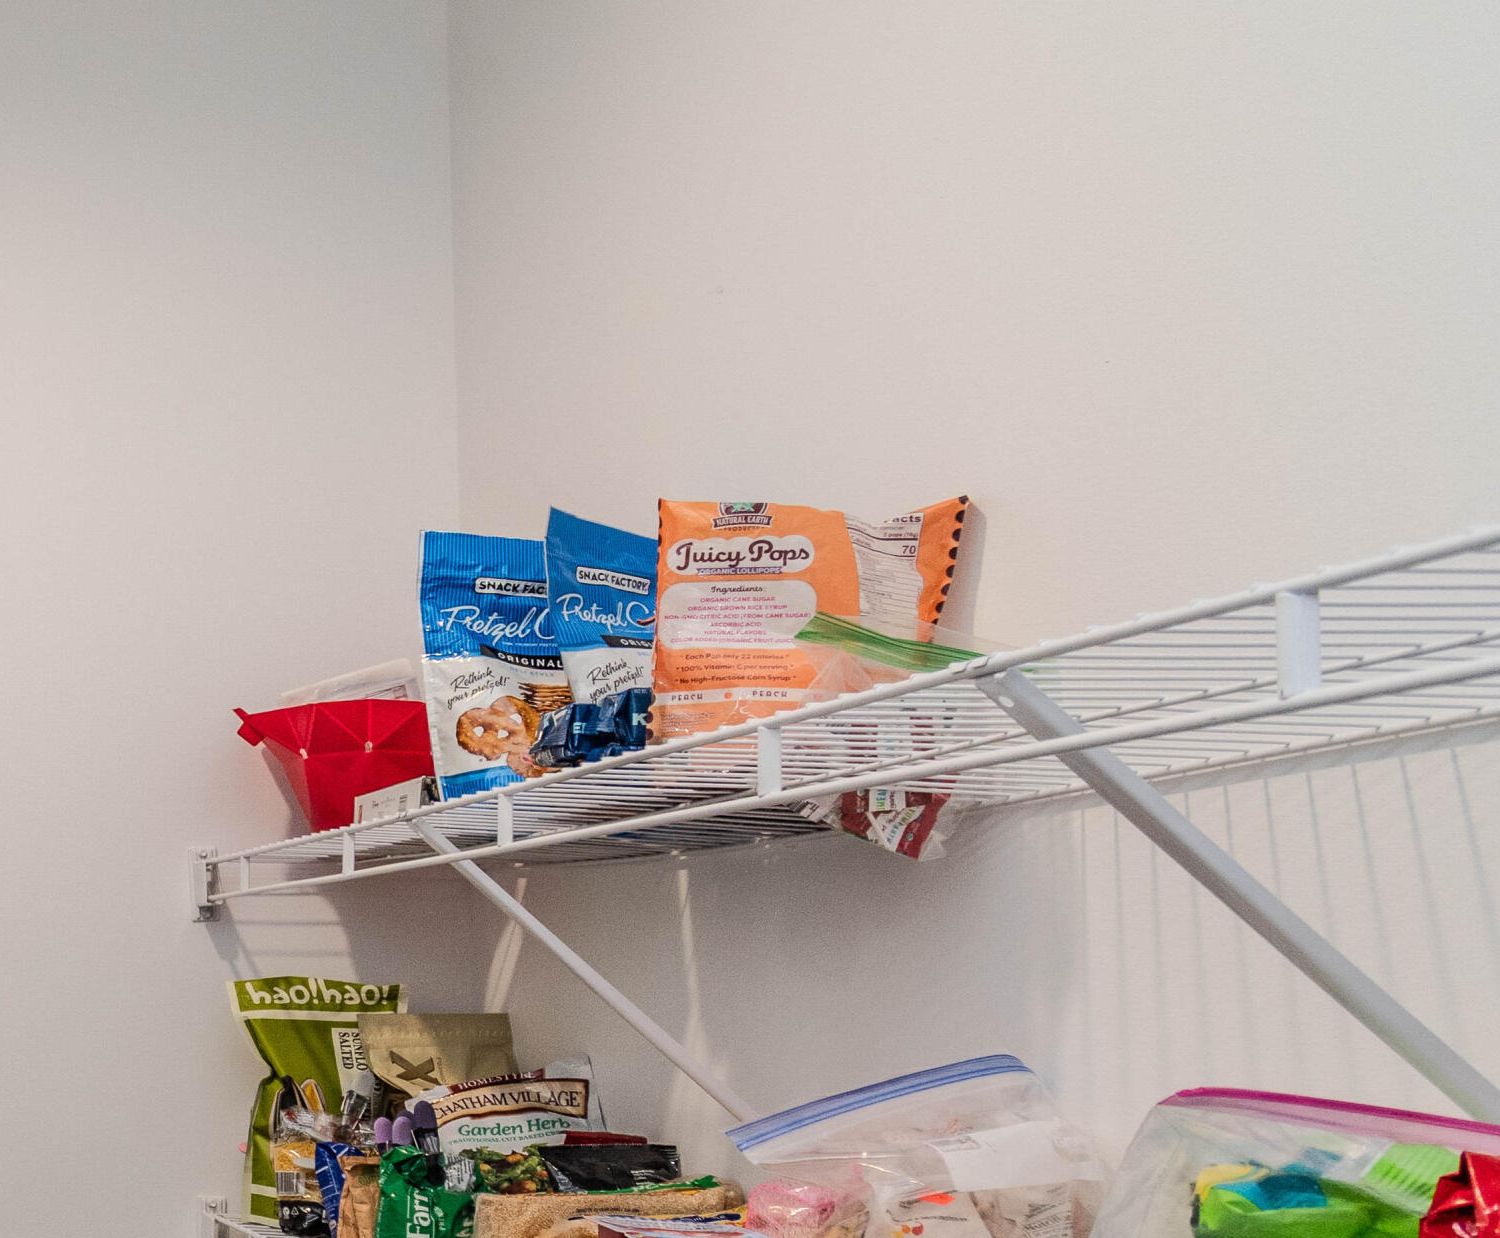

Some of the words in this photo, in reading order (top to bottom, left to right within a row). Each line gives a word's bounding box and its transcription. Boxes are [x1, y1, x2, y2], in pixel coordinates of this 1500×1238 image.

[716, 516, 746, 526] NATURAL
[747, 515, 769, 524] EARTH
[676, 542, 746, 570] Juicy
[748, 540, 810, 566] Pops
[902, 545, 916, 554] 70
[579, 569, 610, 584] SNACK
[611, 575, 648, 591] FACTORY
[699, 567, 735, 576] ORGANIC
[736, 566, 781, 575] LOLLIPOPS
[479, 581, 518, 593] SNACK
[556, 593, 627, 633] Pretzel
[441, 606, 537, 646] Pretzel
[497, 652, 563, 671] ORIGINAL
[587, 658, 631, 684] Rethink
[450, 666, 495, 691] Rethink
[589, 682, 612, 703] your
[339, 1032, 354, 1070] SALTED
[435, 1093, 508, 1119] CHATHAM
[509, 1090, 581, 1108] VILLAGE
[458, 1123, 523, 1137] Garden
[527, 1118, 571, 1132] Herb
